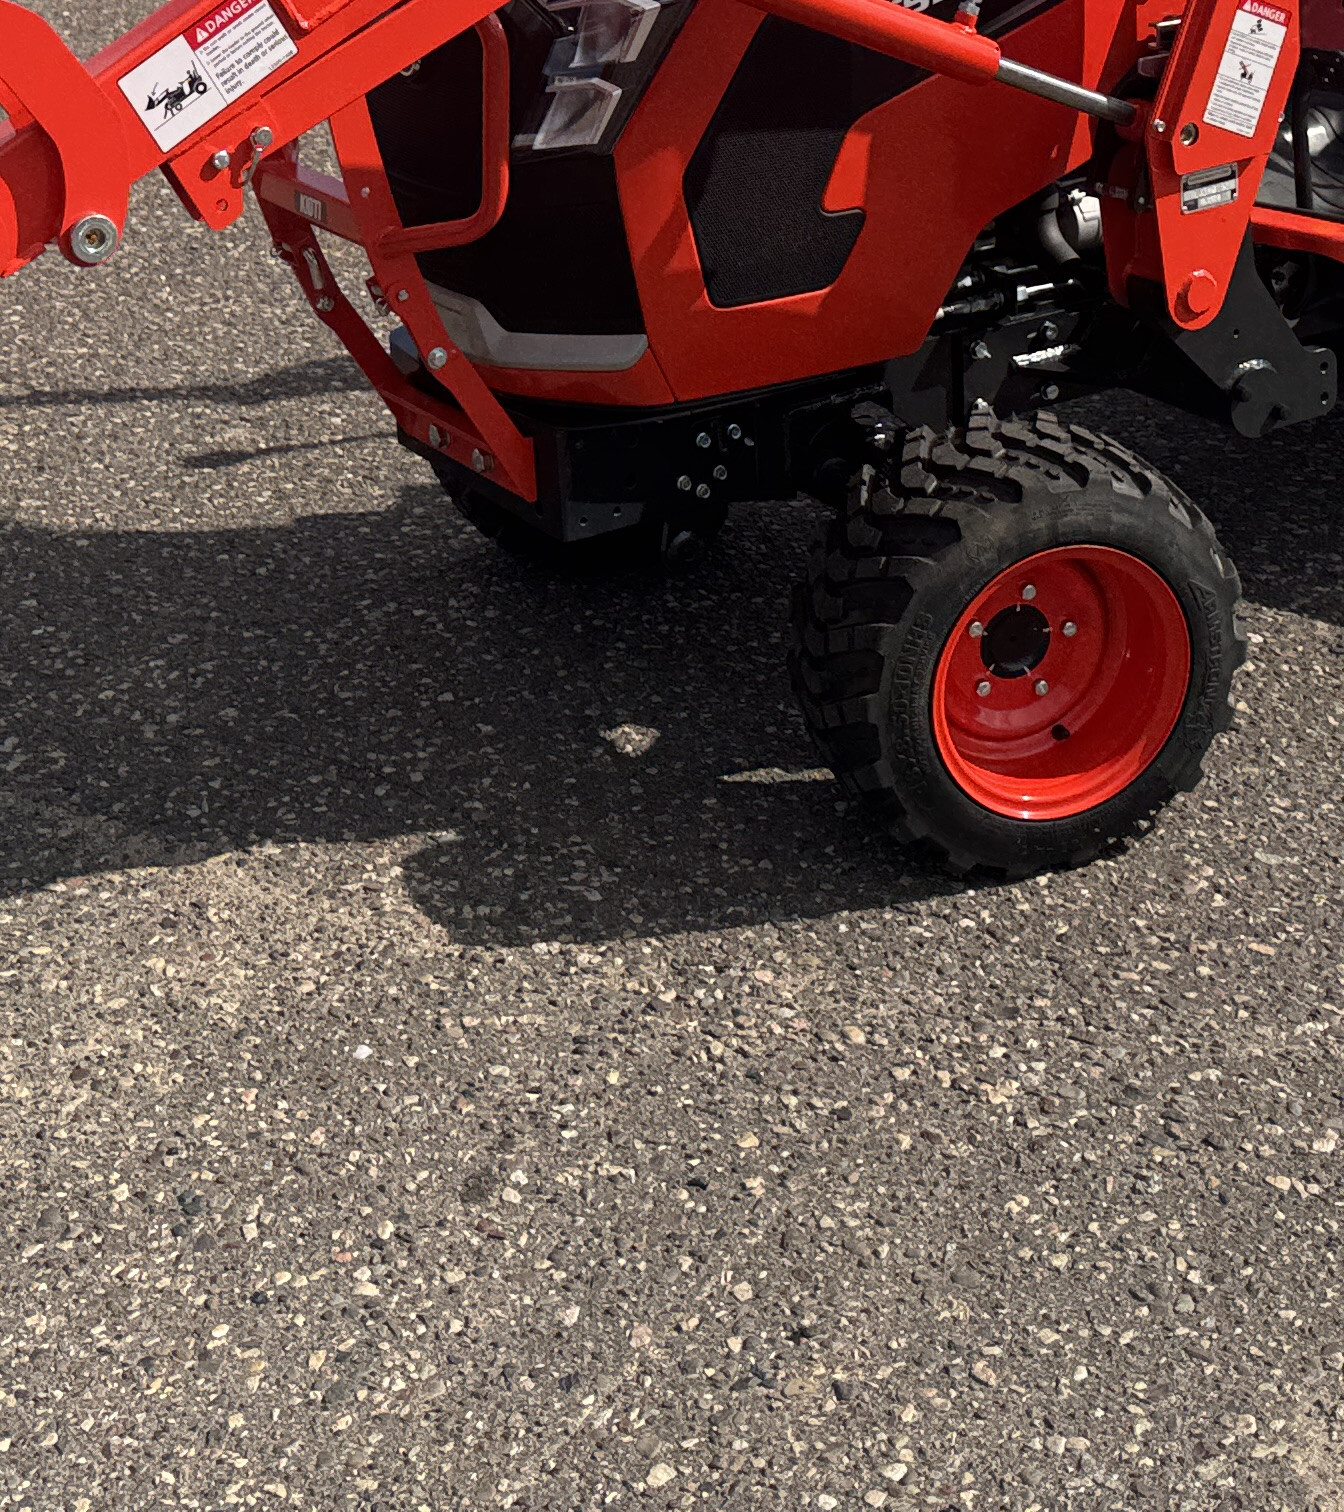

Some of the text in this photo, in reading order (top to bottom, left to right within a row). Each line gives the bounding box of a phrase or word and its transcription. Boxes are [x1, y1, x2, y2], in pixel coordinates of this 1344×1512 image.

[1251, 2, 1286, 22] DANGER
[216, 63, 235, 80] Failure
[243, 42, 263, 59] comply
[264, 28, 279, 44] could
[221, 72, 238, 87] result
[237, 67, 244, 75] in
[244, 55, 261, 70] death
[261, 49, 268, 57] or
[268, 34, 288, 51] serious
